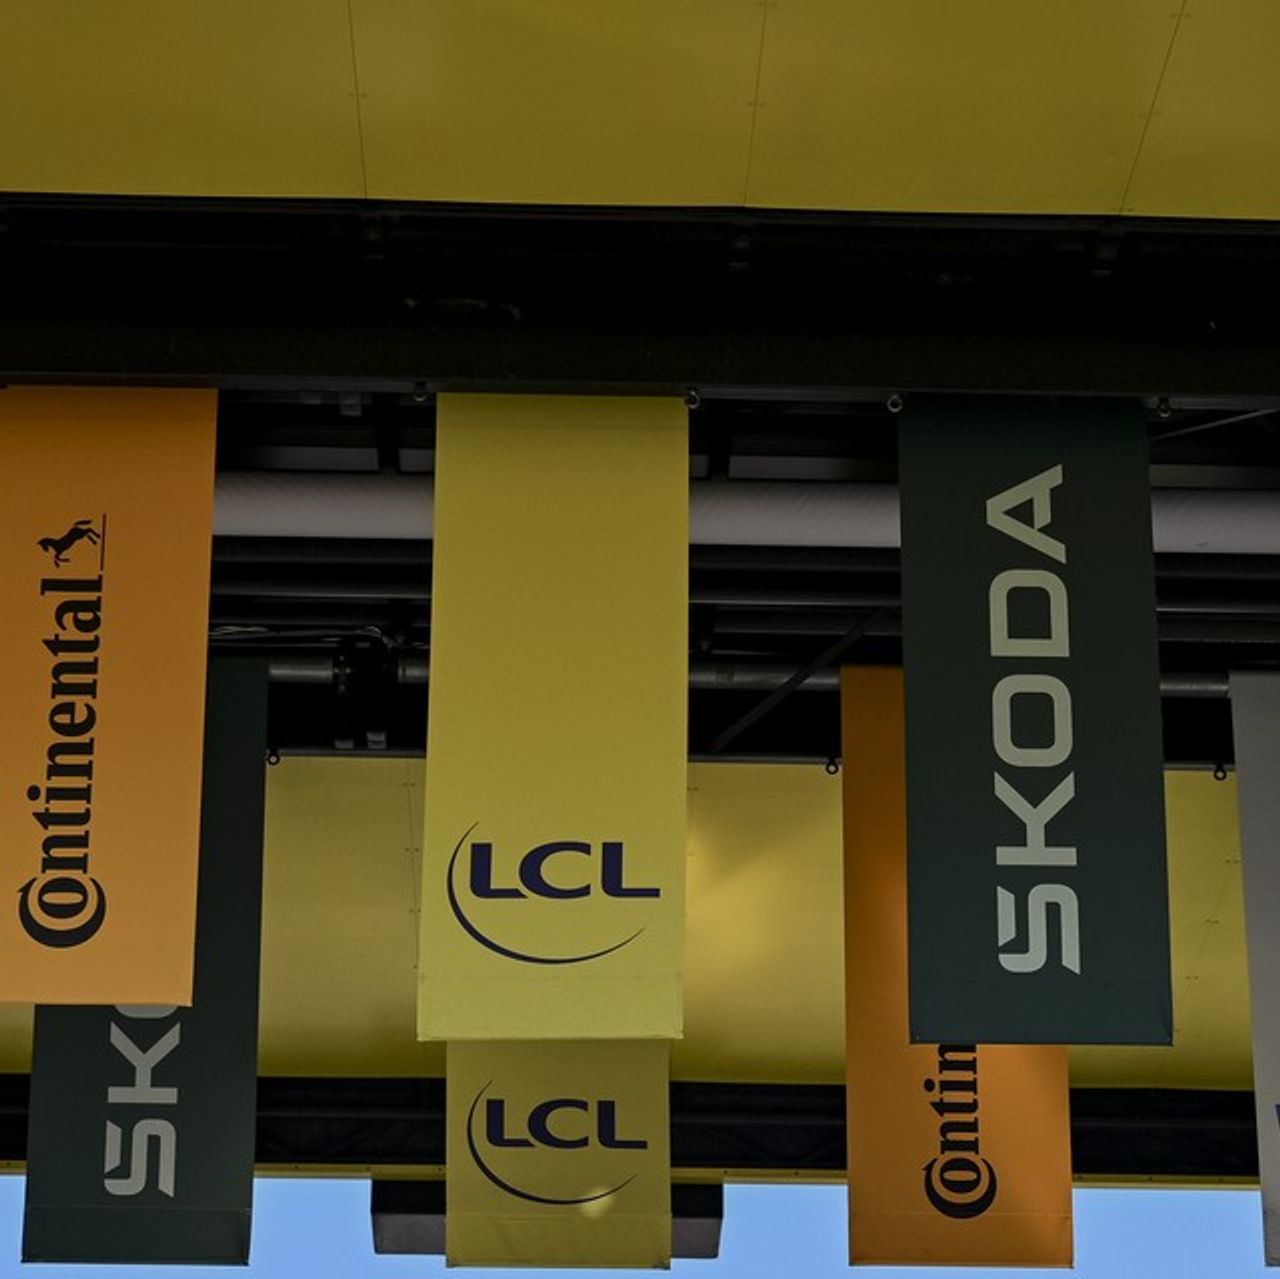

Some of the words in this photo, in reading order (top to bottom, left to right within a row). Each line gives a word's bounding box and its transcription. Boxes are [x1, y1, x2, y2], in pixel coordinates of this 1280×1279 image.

[19, 573, 107, 949] Continental
[468, 842, 660, 899] LCL
[486, 1098, 647, 1148] LCL
[922, 1044, 997, 1219] Contin
